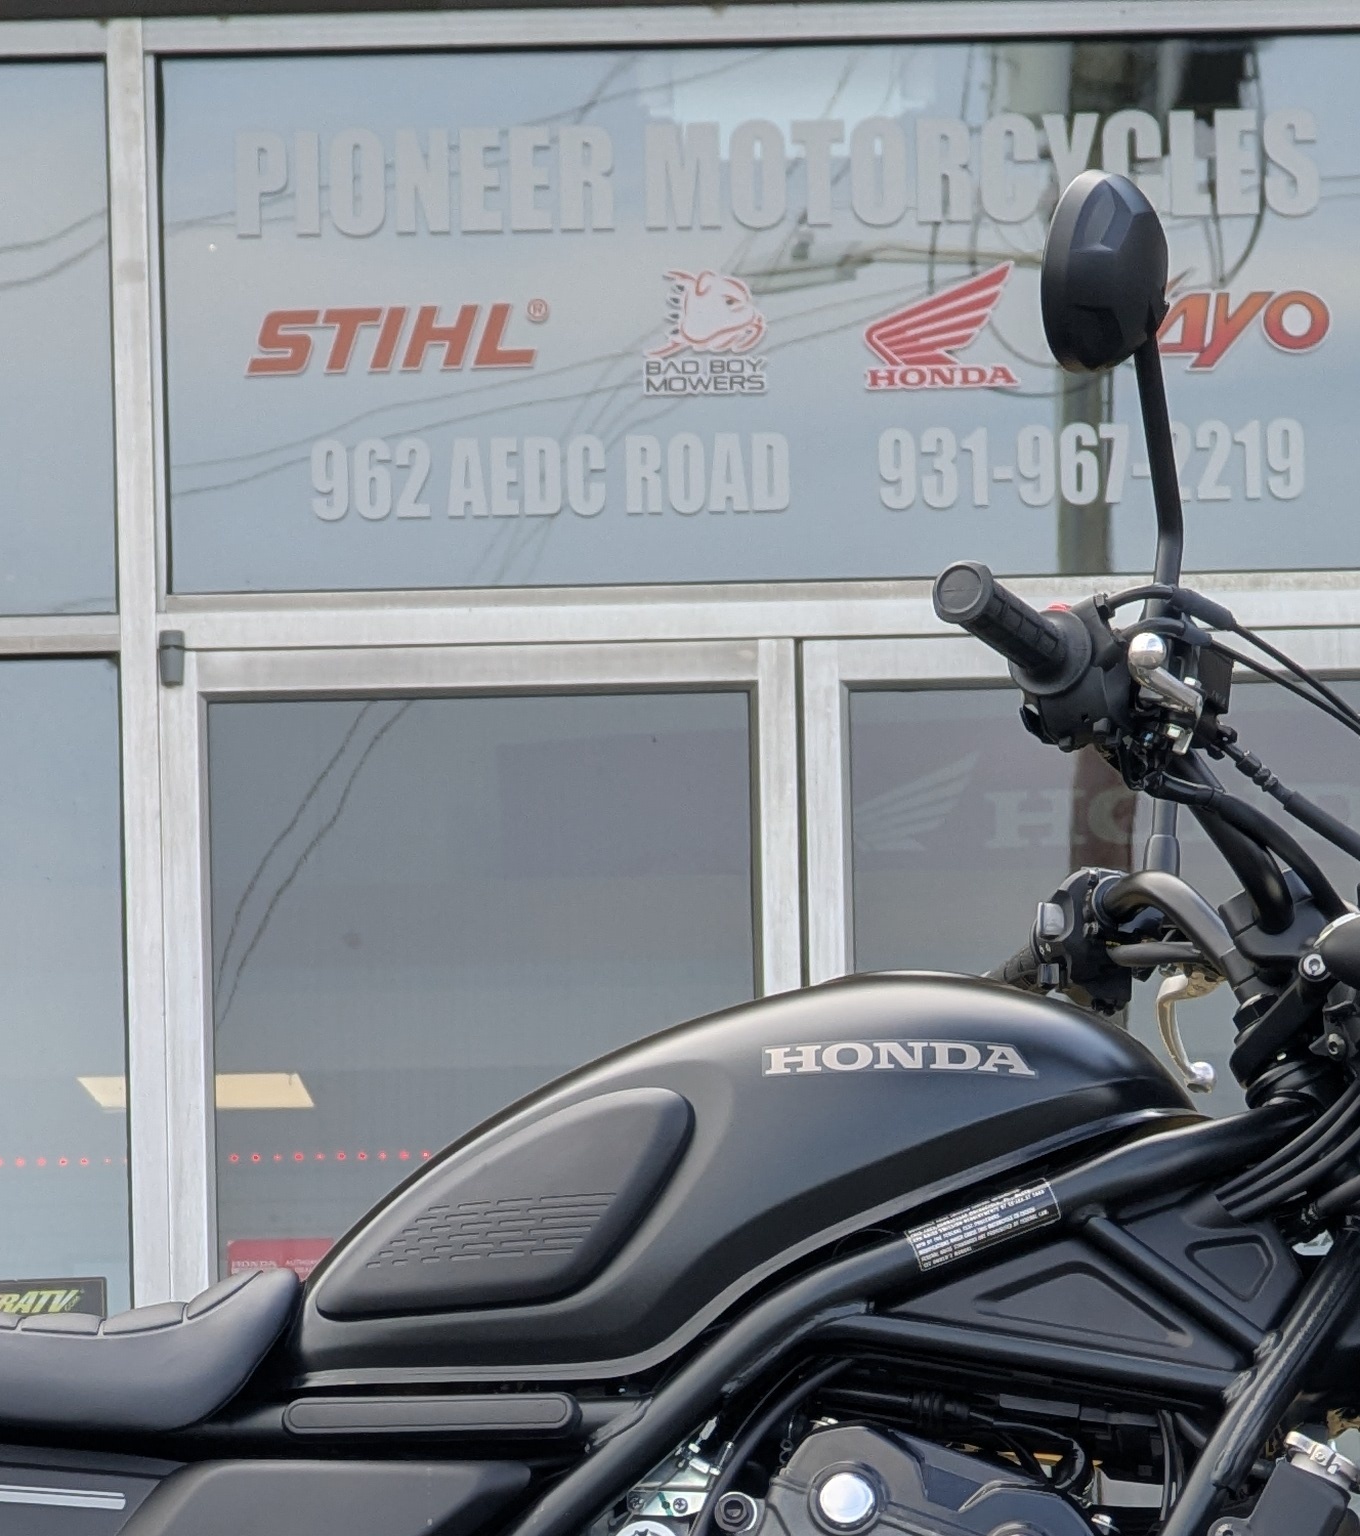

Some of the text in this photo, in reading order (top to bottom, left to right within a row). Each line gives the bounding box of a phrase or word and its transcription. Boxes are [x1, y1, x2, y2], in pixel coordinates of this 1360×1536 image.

[235, 108, 1321, 239] PIONEER MOTORCYCLES
[247, 302, 536, 376] STIHL
[1157, 268, 1330, 371] AYO
[645, 358, 762, 375] BAD BOY
[645, 375, 765, 392] MOWERS
[867, 366, 1019, 388] HONDA
[310, 430, 791, 521] 962 AEDC ROAD
[765, 1042, 1036, 1076] HONDA
